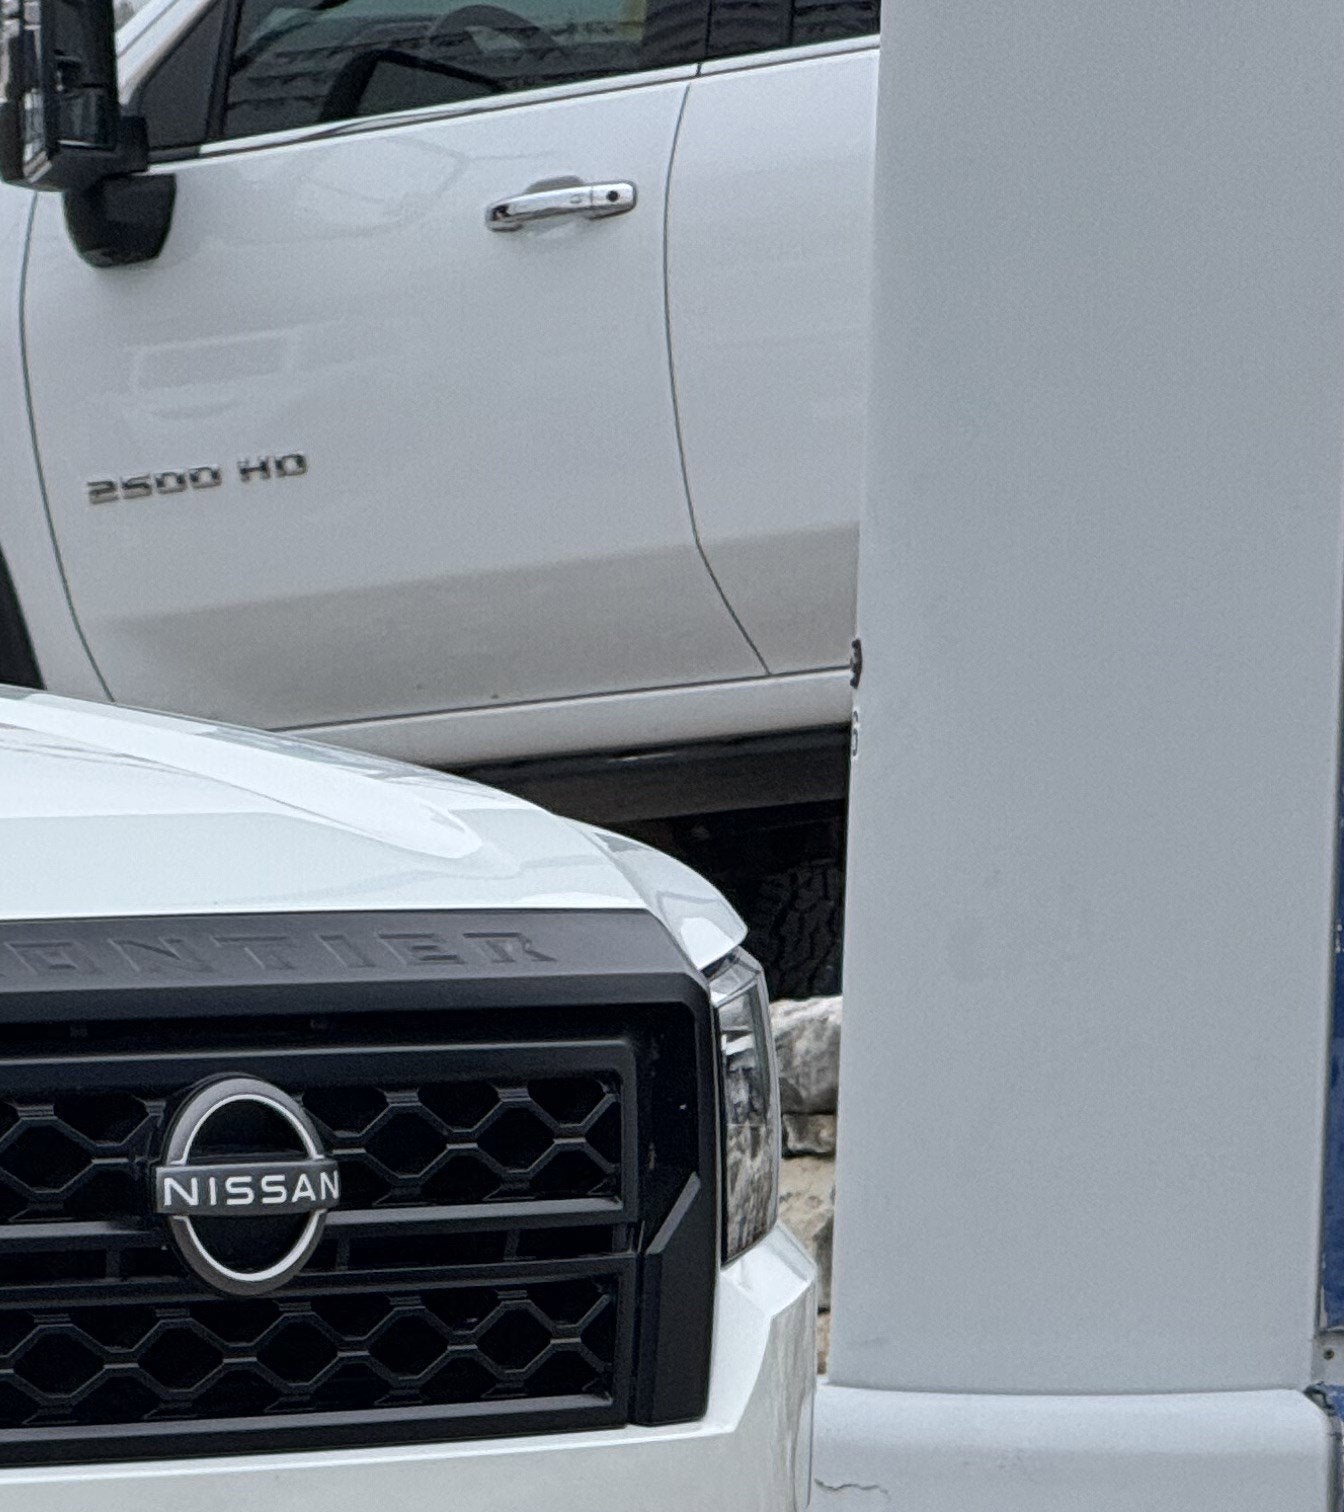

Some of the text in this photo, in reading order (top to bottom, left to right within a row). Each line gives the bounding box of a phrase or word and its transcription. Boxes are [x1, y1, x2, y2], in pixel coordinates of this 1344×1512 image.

[87, 453, 307, 505] 2500 HD
[164, 1170, 340, 1206] NISSAN
